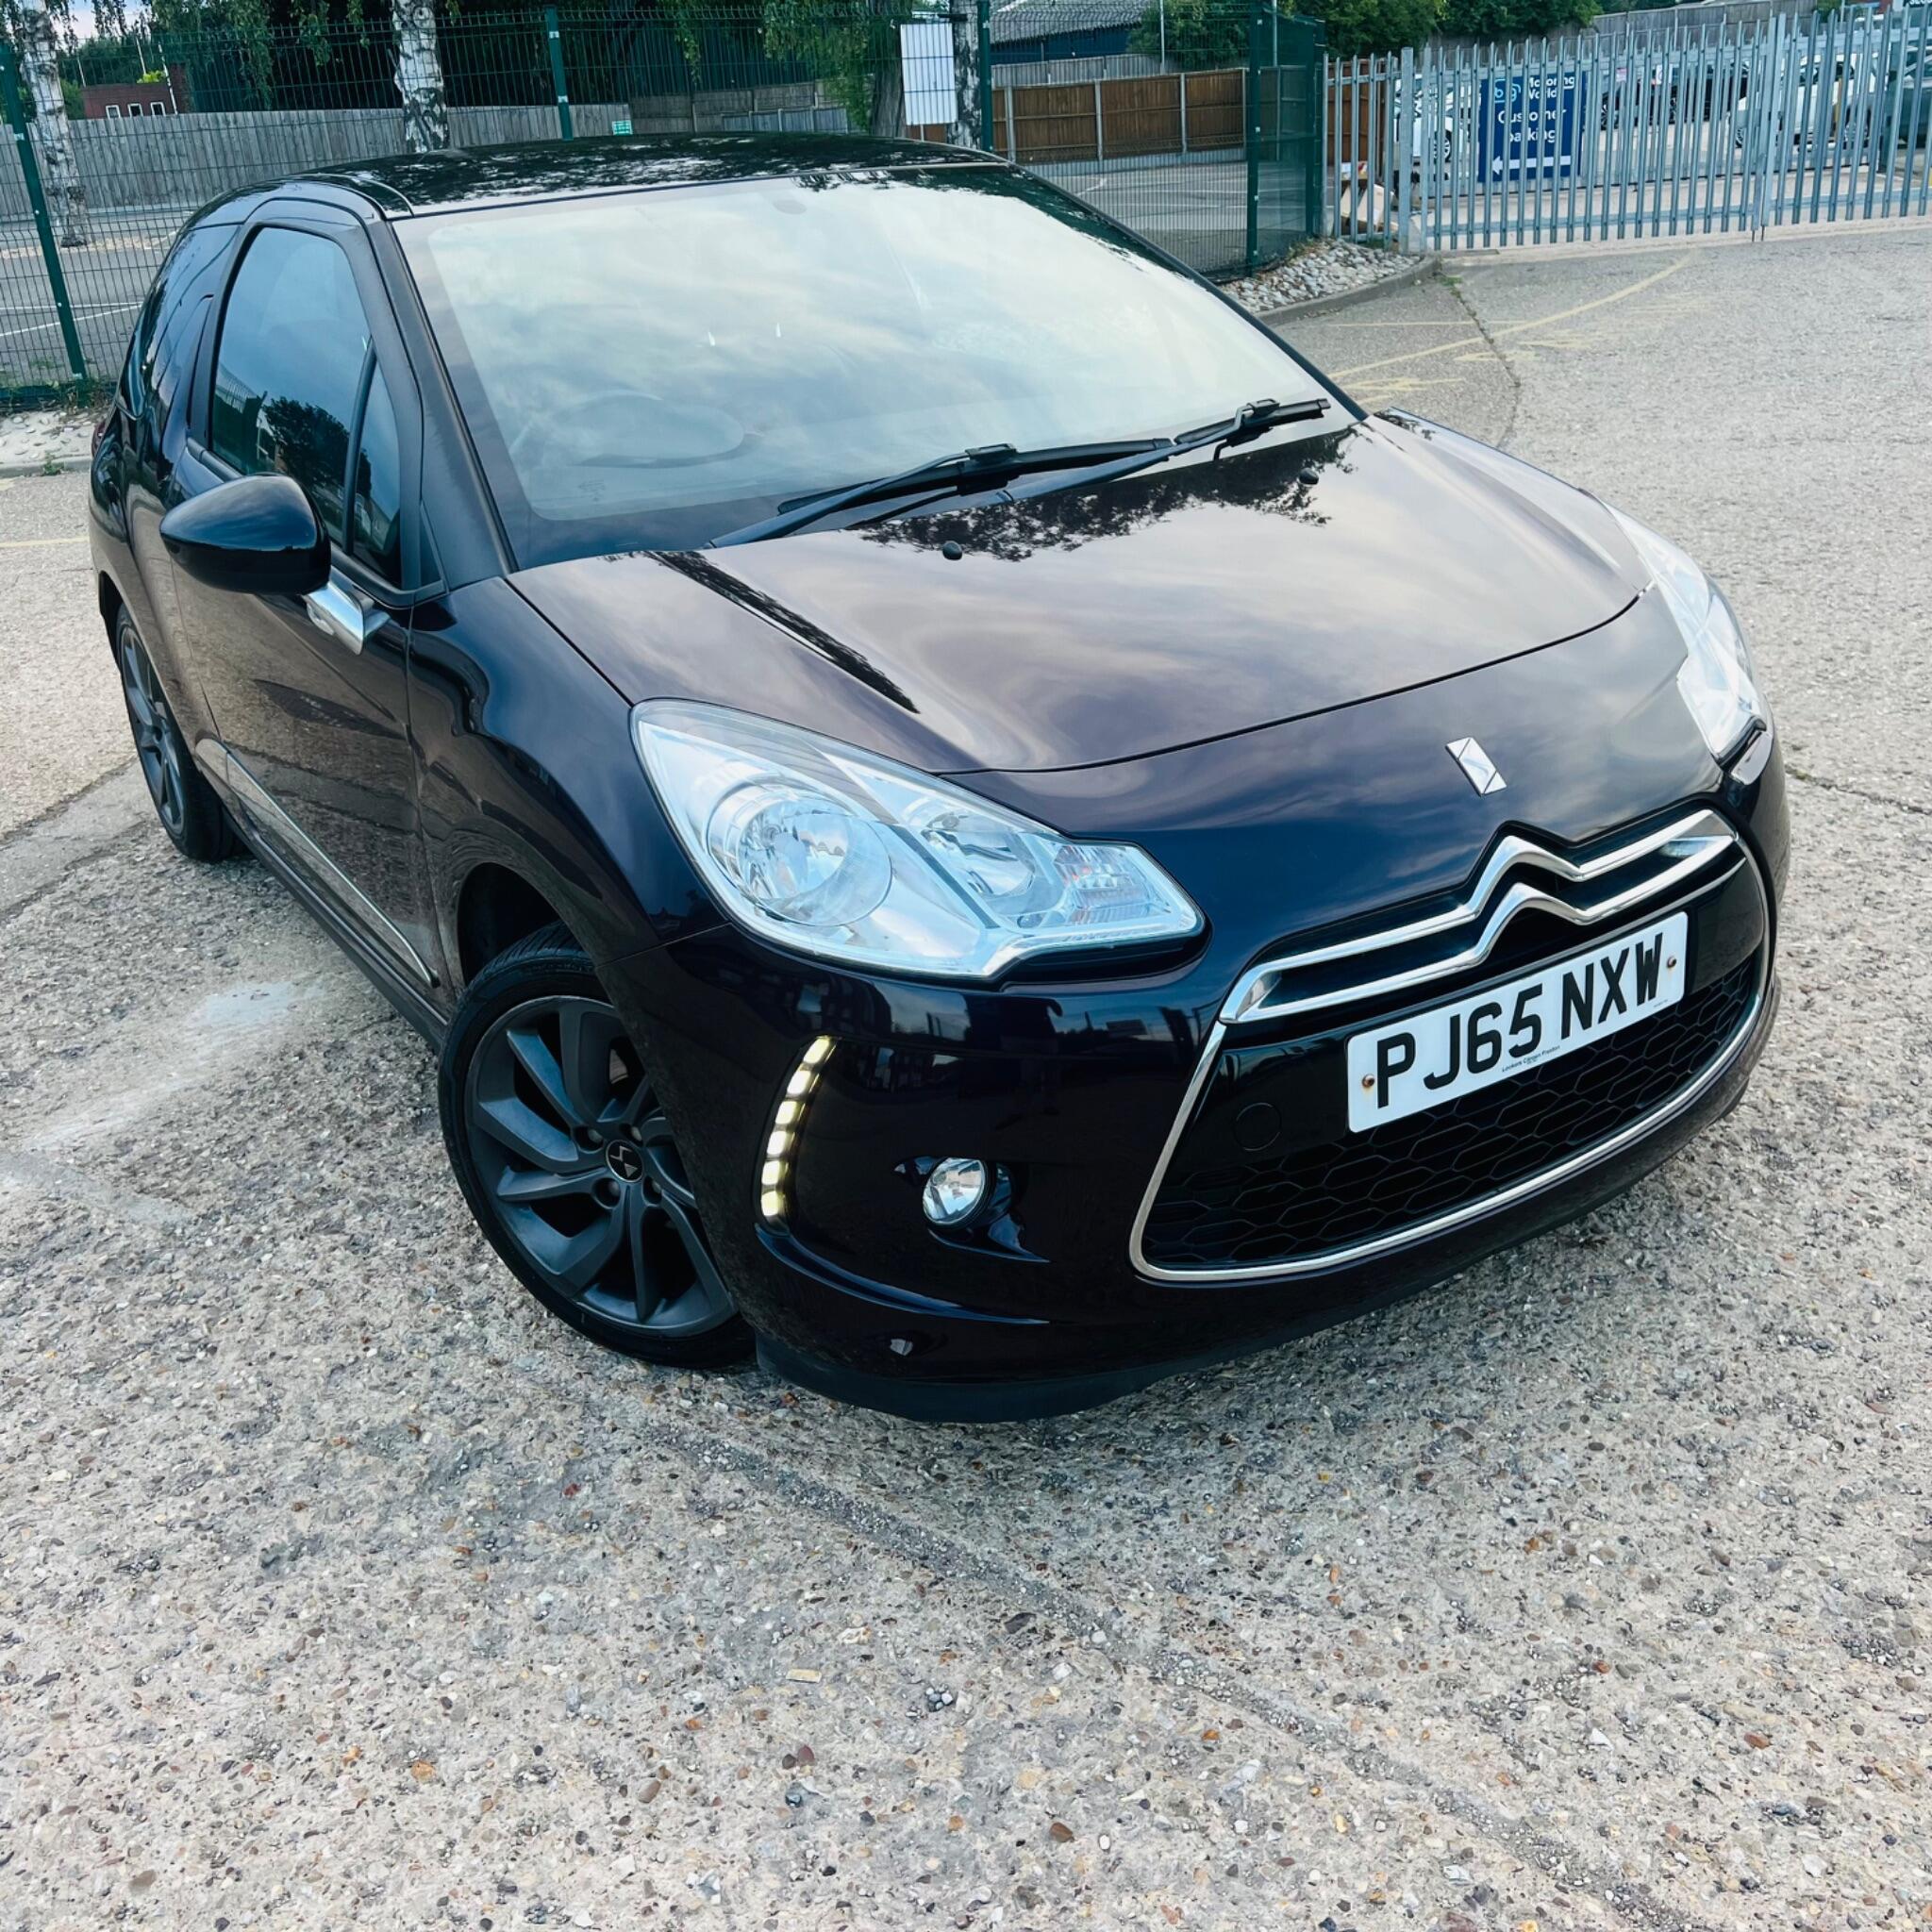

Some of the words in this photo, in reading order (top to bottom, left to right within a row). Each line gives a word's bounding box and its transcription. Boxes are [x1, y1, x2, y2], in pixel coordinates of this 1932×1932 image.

[1524, 87, 1558, 99] Wold
[1498, 108, 1567, 124] Cusomer
[1507, 126, 1556, 144] akig
[1376, 982, 1543, 1109] PJ65
[1561, 932, 1663, 1041] NXW
